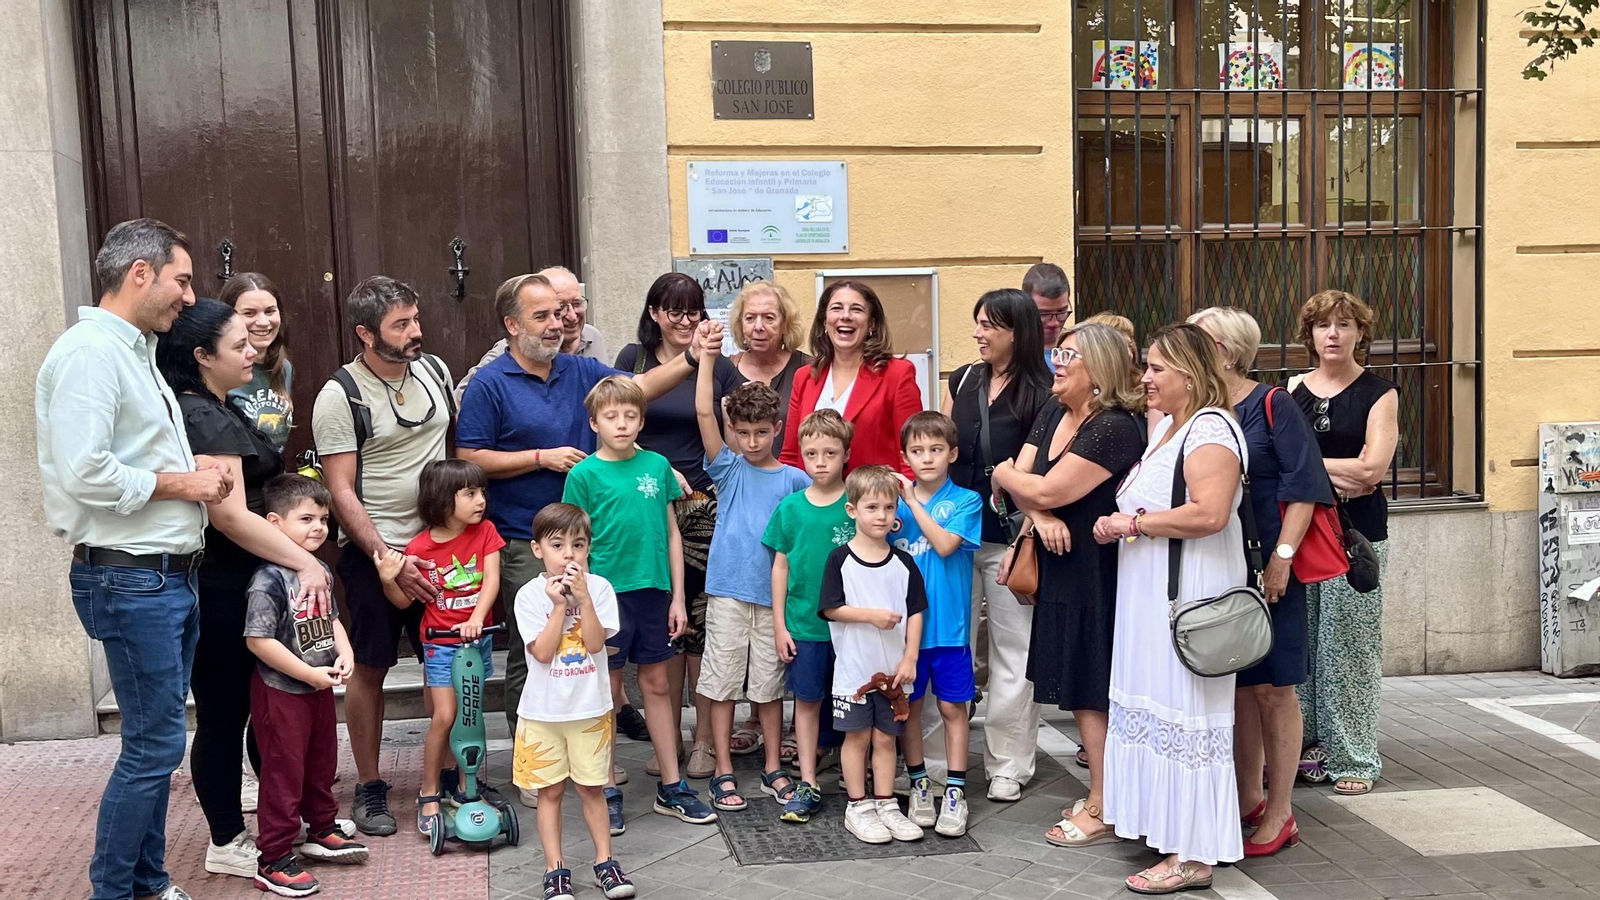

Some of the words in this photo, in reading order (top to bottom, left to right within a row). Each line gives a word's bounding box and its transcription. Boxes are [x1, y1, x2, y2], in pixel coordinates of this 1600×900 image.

[717, 79, 762, 95] COLEGIO
[765, 80, 808, 95] PUBLICO
[733, 100, 759, 114] SAN
[764, 100, 794, 114] JOSE
[705, 169, 739, 177] Reforma
[747, 169, 779, 178] Mejoras
[792, 169, 800, 177] el
[802, 169, 831, 178] Colegio
[705, 178, 746, 186] Educación
[784, 178, 817, 186] Primaria
[766, 187, 799, 195] Granada
[472, 674, 480, 709] RIDE
[462, 675, 471, 727] SCOOT
[837, 700, 851, 712] FOR
